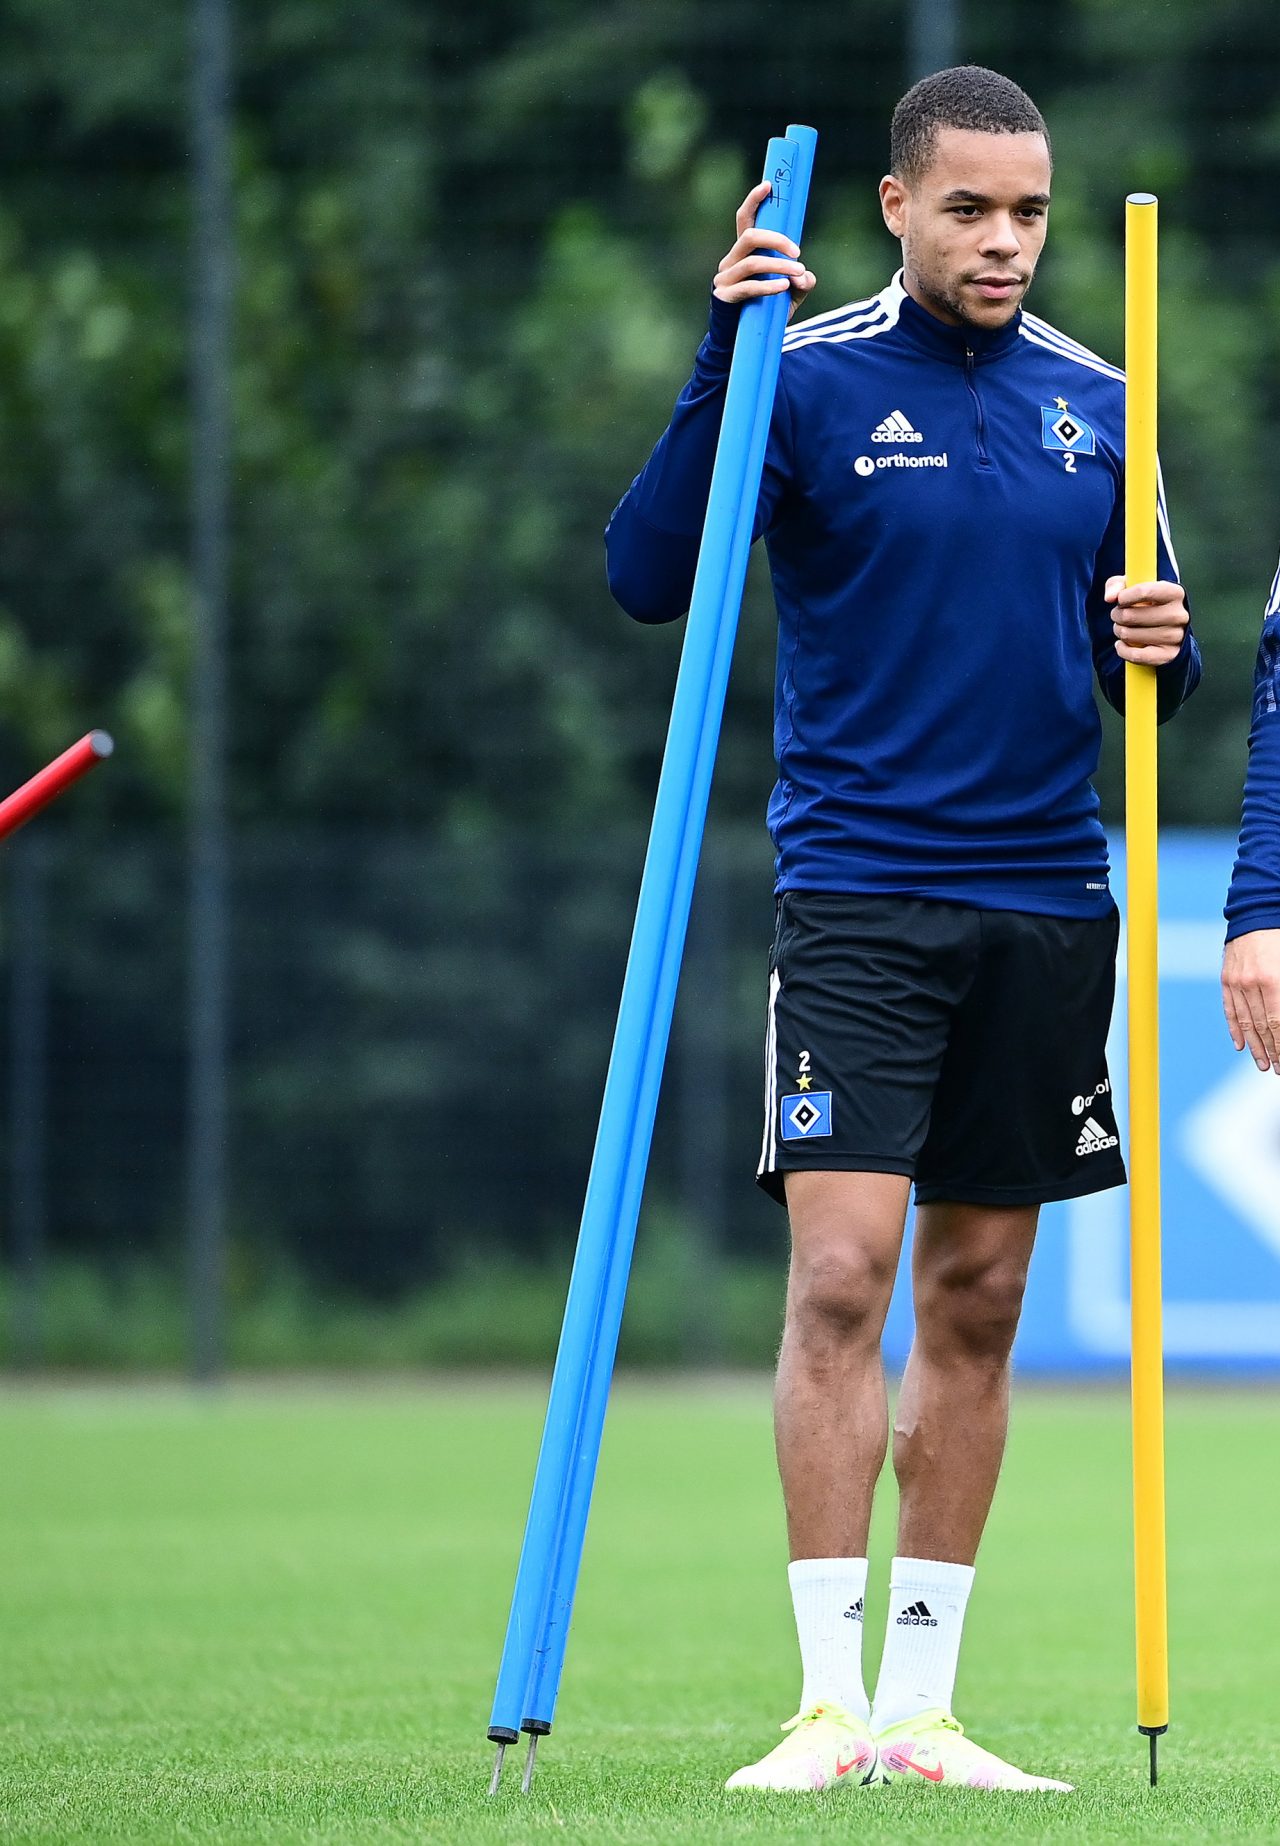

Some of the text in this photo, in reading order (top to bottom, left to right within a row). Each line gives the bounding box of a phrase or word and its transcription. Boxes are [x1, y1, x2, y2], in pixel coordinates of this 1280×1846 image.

[871, 431, 923, 443] adidas
[876, 453, 948, 468] orthomol
[1063, 452, 1077, 473] 2
[798, 1050, 811, 1072] 2
[1075, 1136, 1118, 1156] adidas
[896, 1615, 938, 1627] adidas
